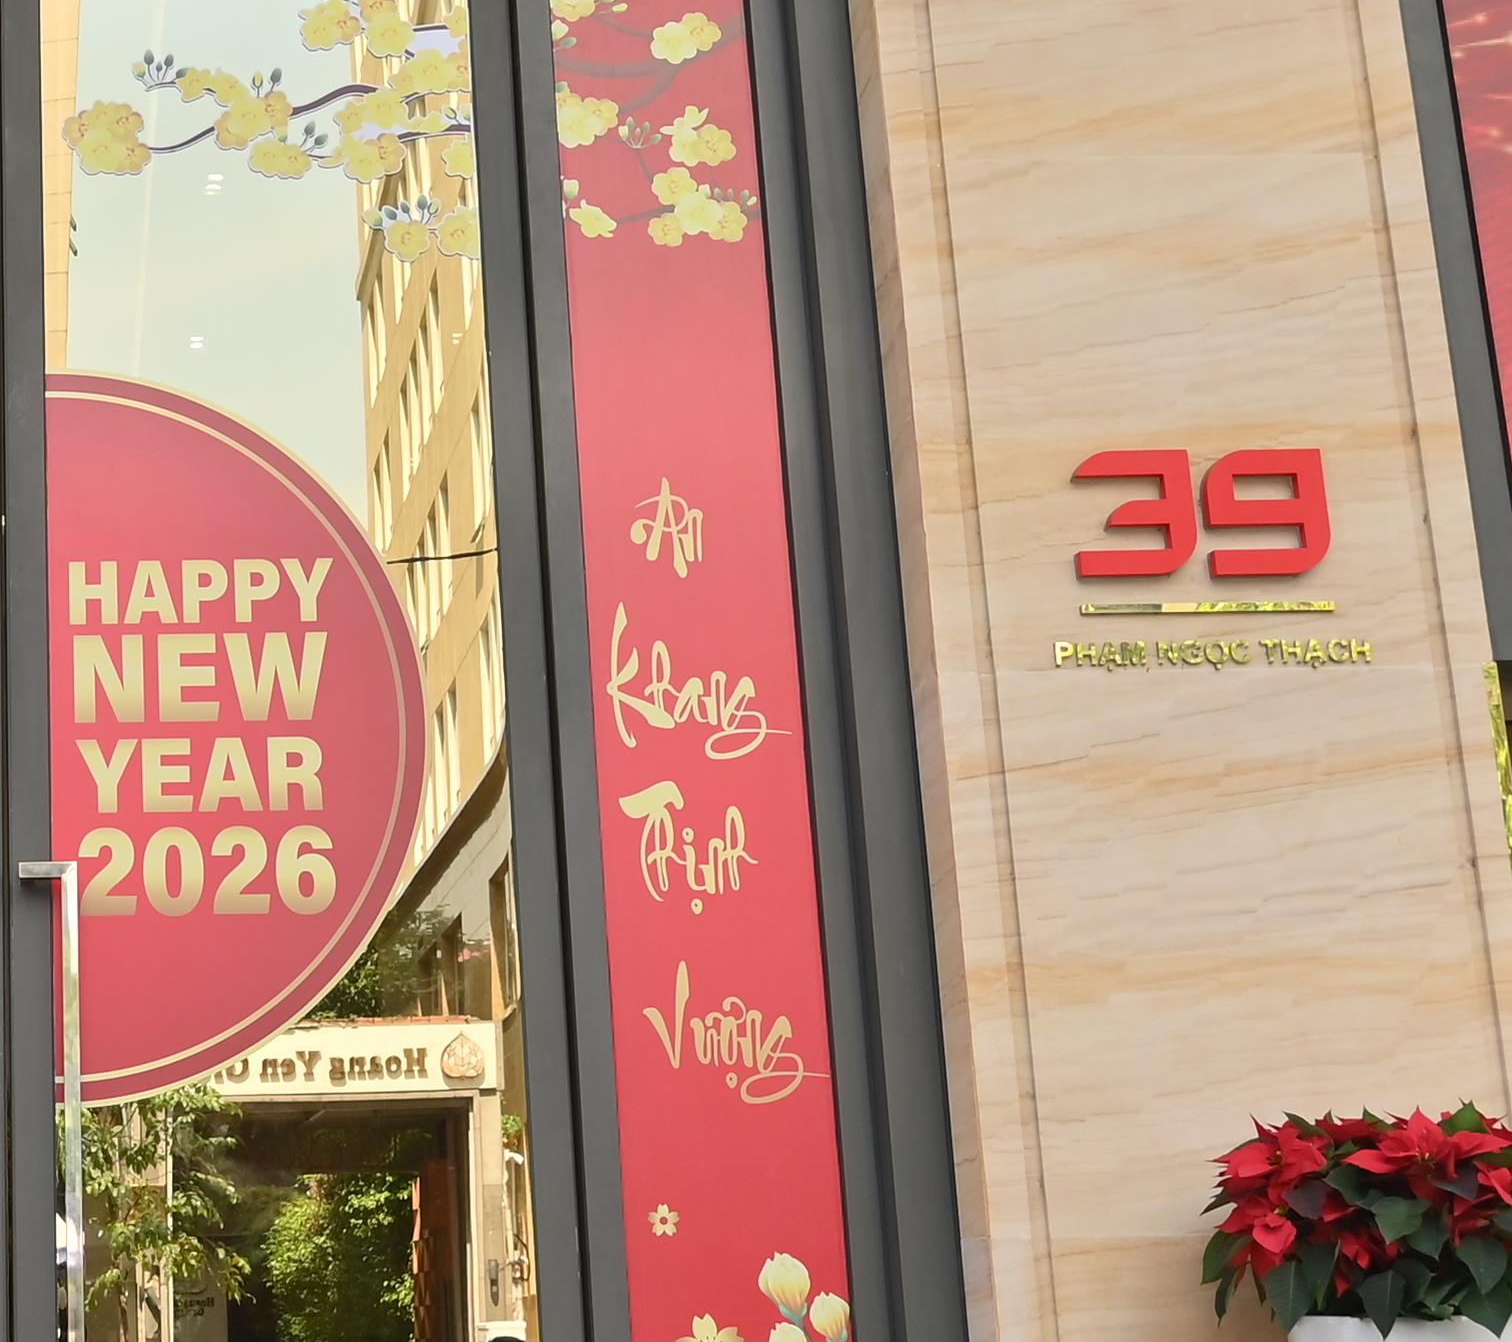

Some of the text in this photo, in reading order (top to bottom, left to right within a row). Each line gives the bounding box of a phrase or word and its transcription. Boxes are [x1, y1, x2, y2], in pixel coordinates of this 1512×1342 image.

[630, 476, 704, 578] An
[1070, 448, 1332, 581] 39
[67, 556, 335, 626] HAPPY
[73, 630, 328, 723] NEW
[605, 601, 792, 760] Khang
[1052, 637, 1373, 672] PHẠM NGỌC THẠCH
[76, 735, 325, 813] YEAR
[77, 825, 338, 918] 2026
[618, 780, 759, 915] Thịnh
